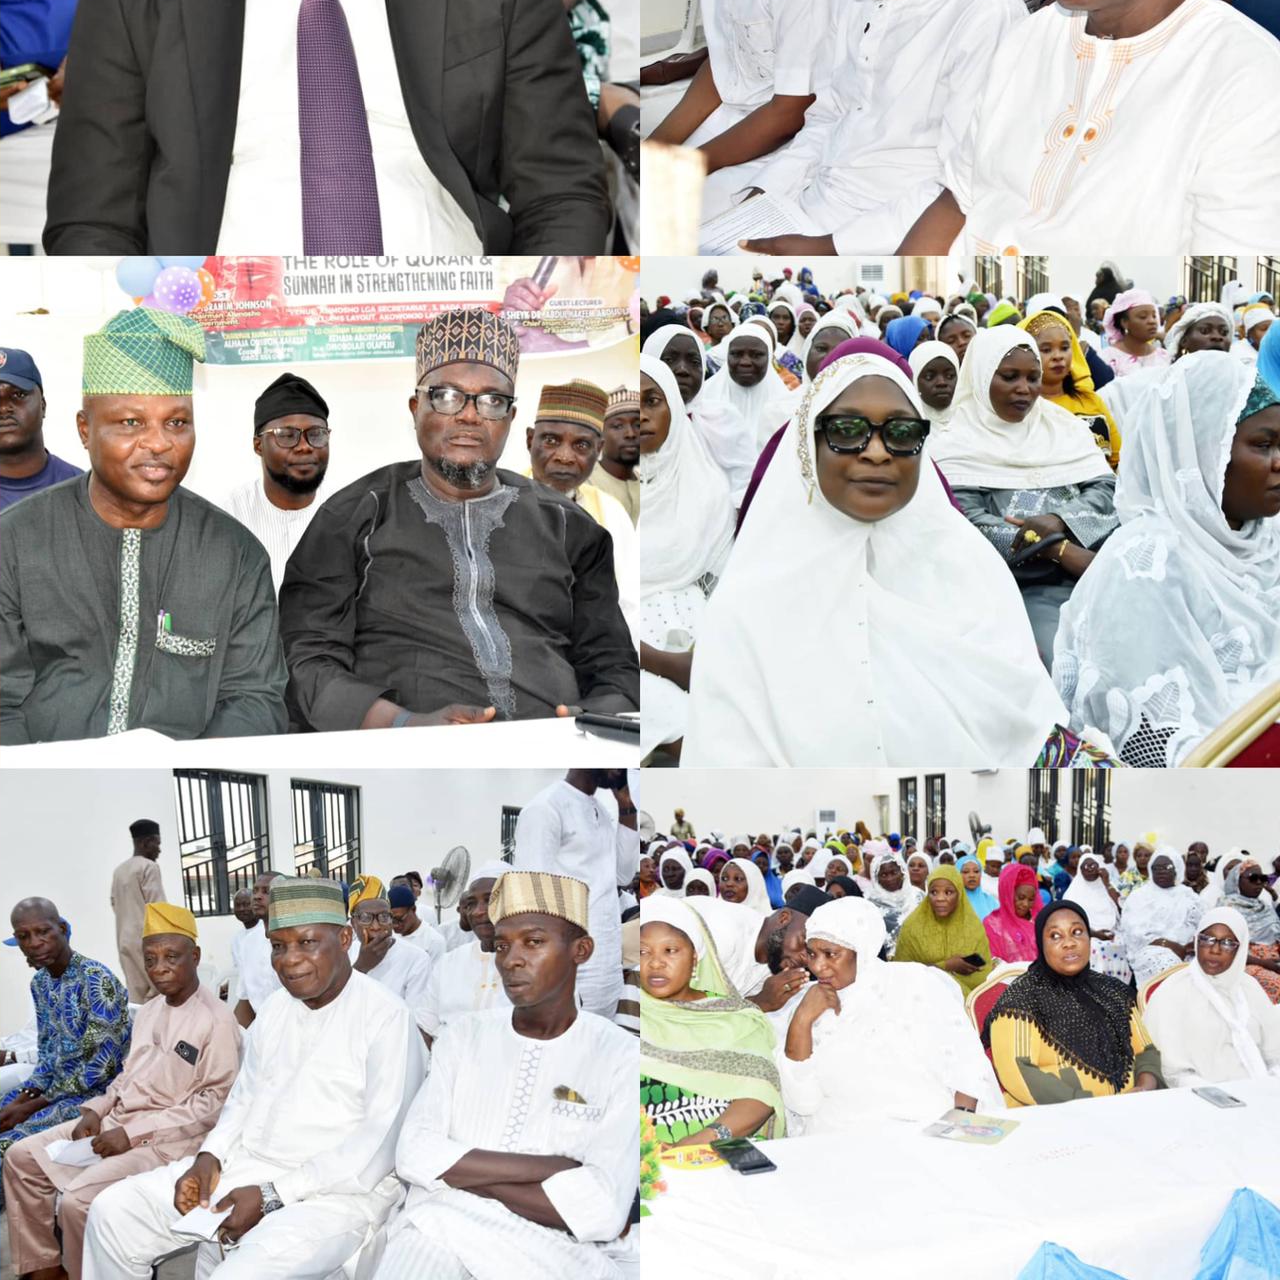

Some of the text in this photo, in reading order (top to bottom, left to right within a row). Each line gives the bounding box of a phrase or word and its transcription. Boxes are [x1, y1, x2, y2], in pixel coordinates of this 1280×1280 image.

[284, 256, 402, 271] THE ROLE OF
[284, 271, 494, 296] SUNNAH IN STRENGTHENING FAITH
[235, 301, 272, 310] JOHNSON
